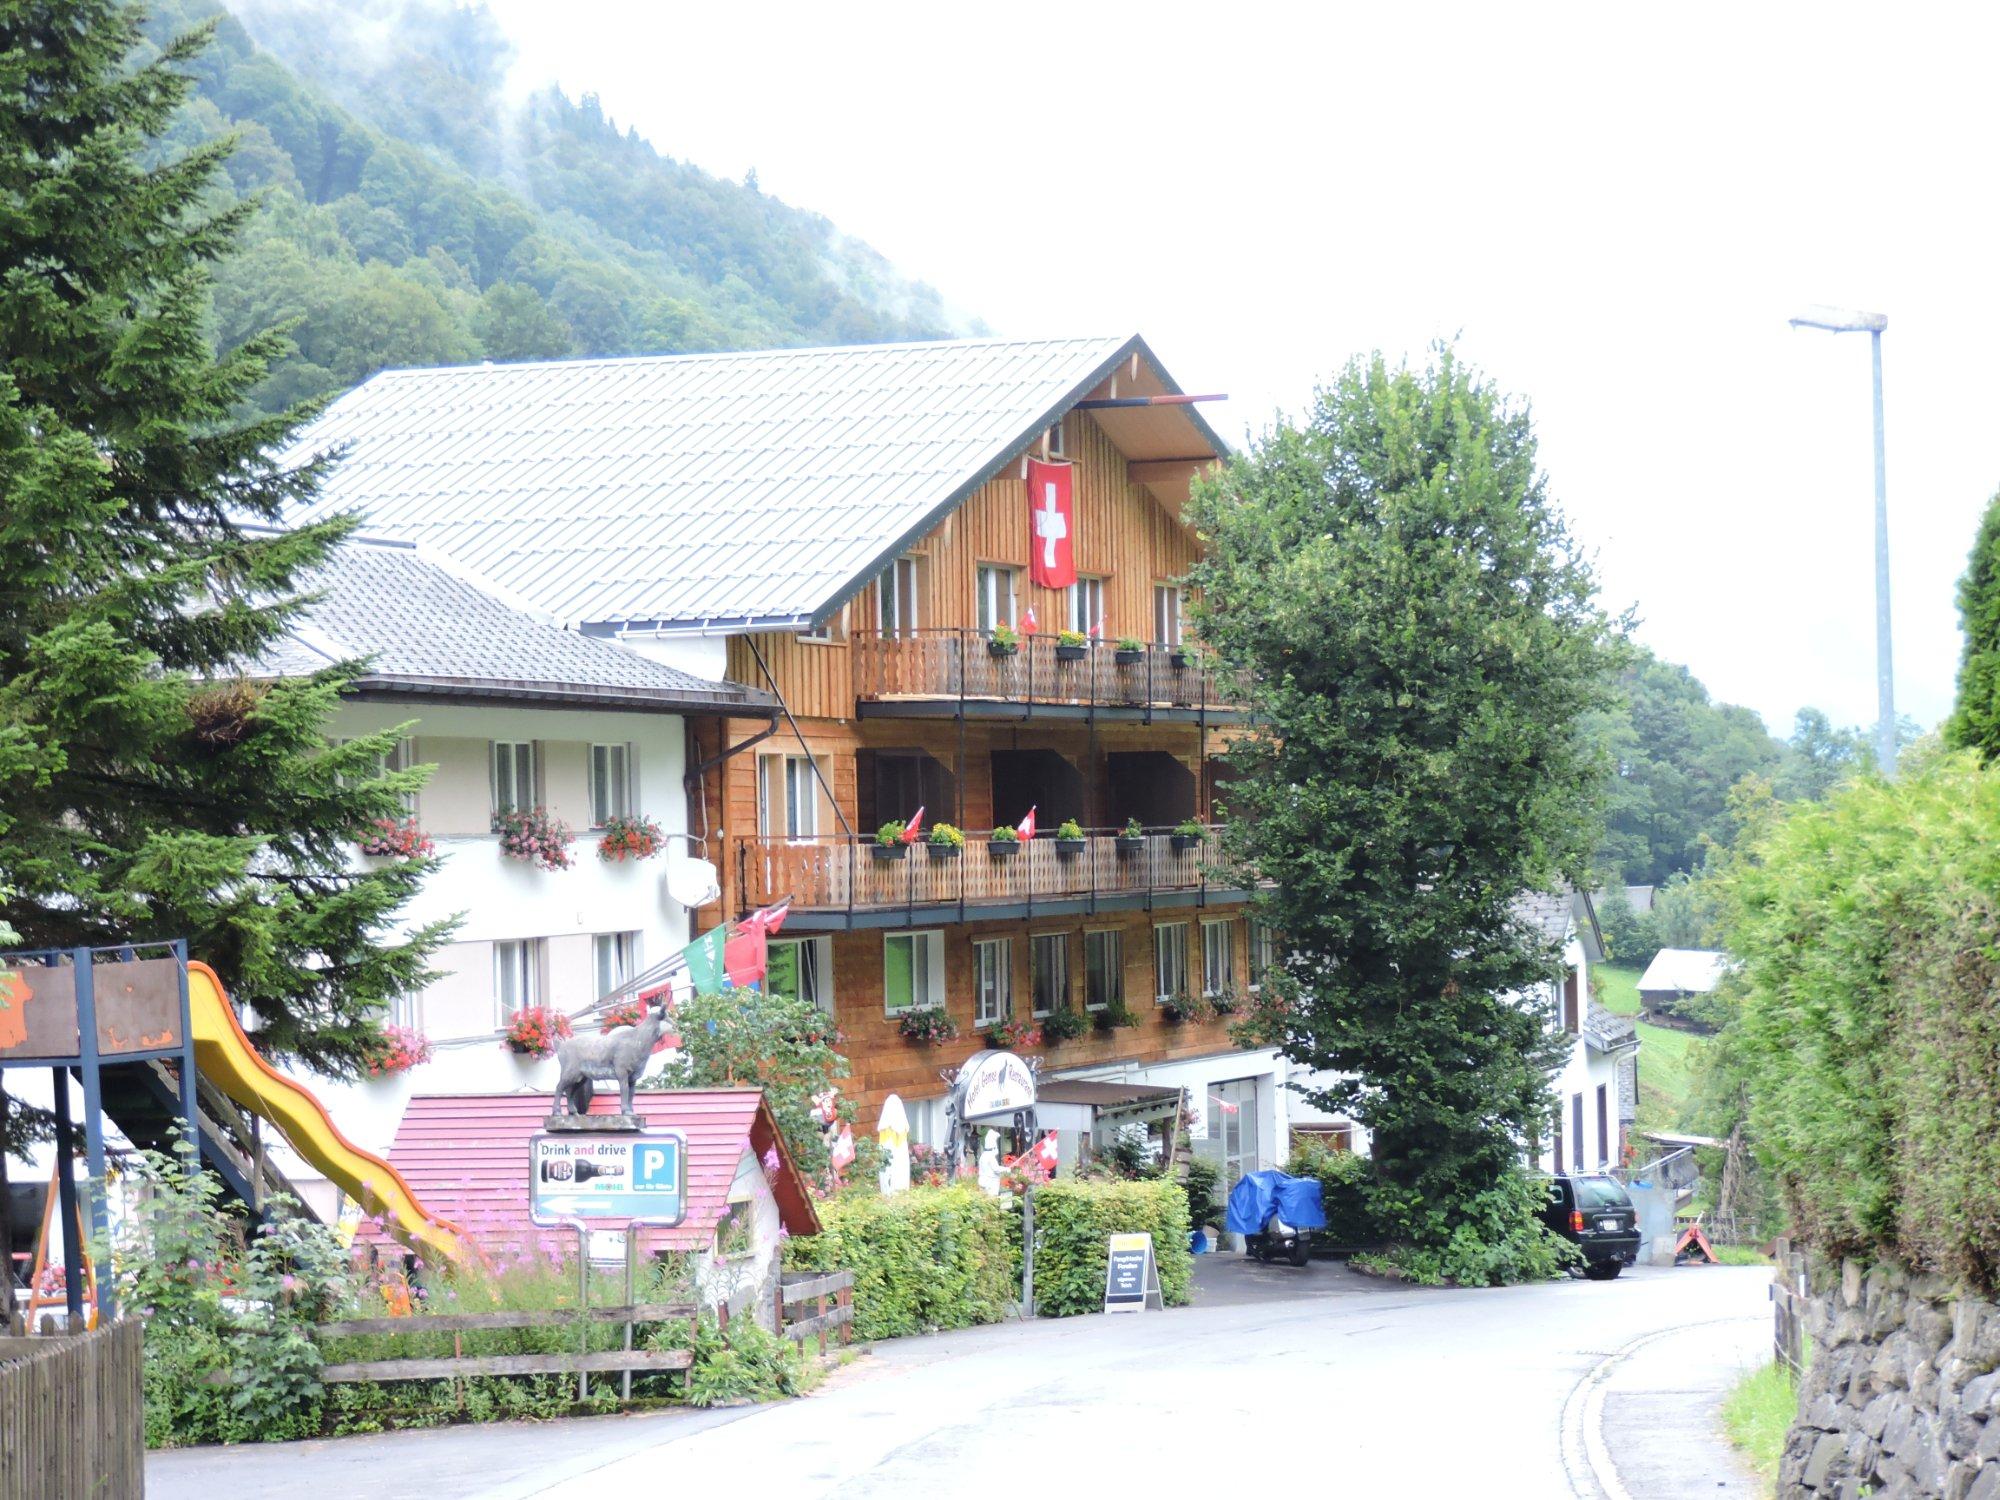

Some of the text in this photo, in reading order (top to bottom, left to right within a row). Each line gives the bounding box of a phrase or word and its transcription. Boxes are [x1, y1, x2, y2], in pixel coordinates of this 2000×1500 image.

[966, 1077, 981, 1110] Hotel
[541, 1144, 627, 1156] Drink and drive
[644, 1149, 665, 1180] P
